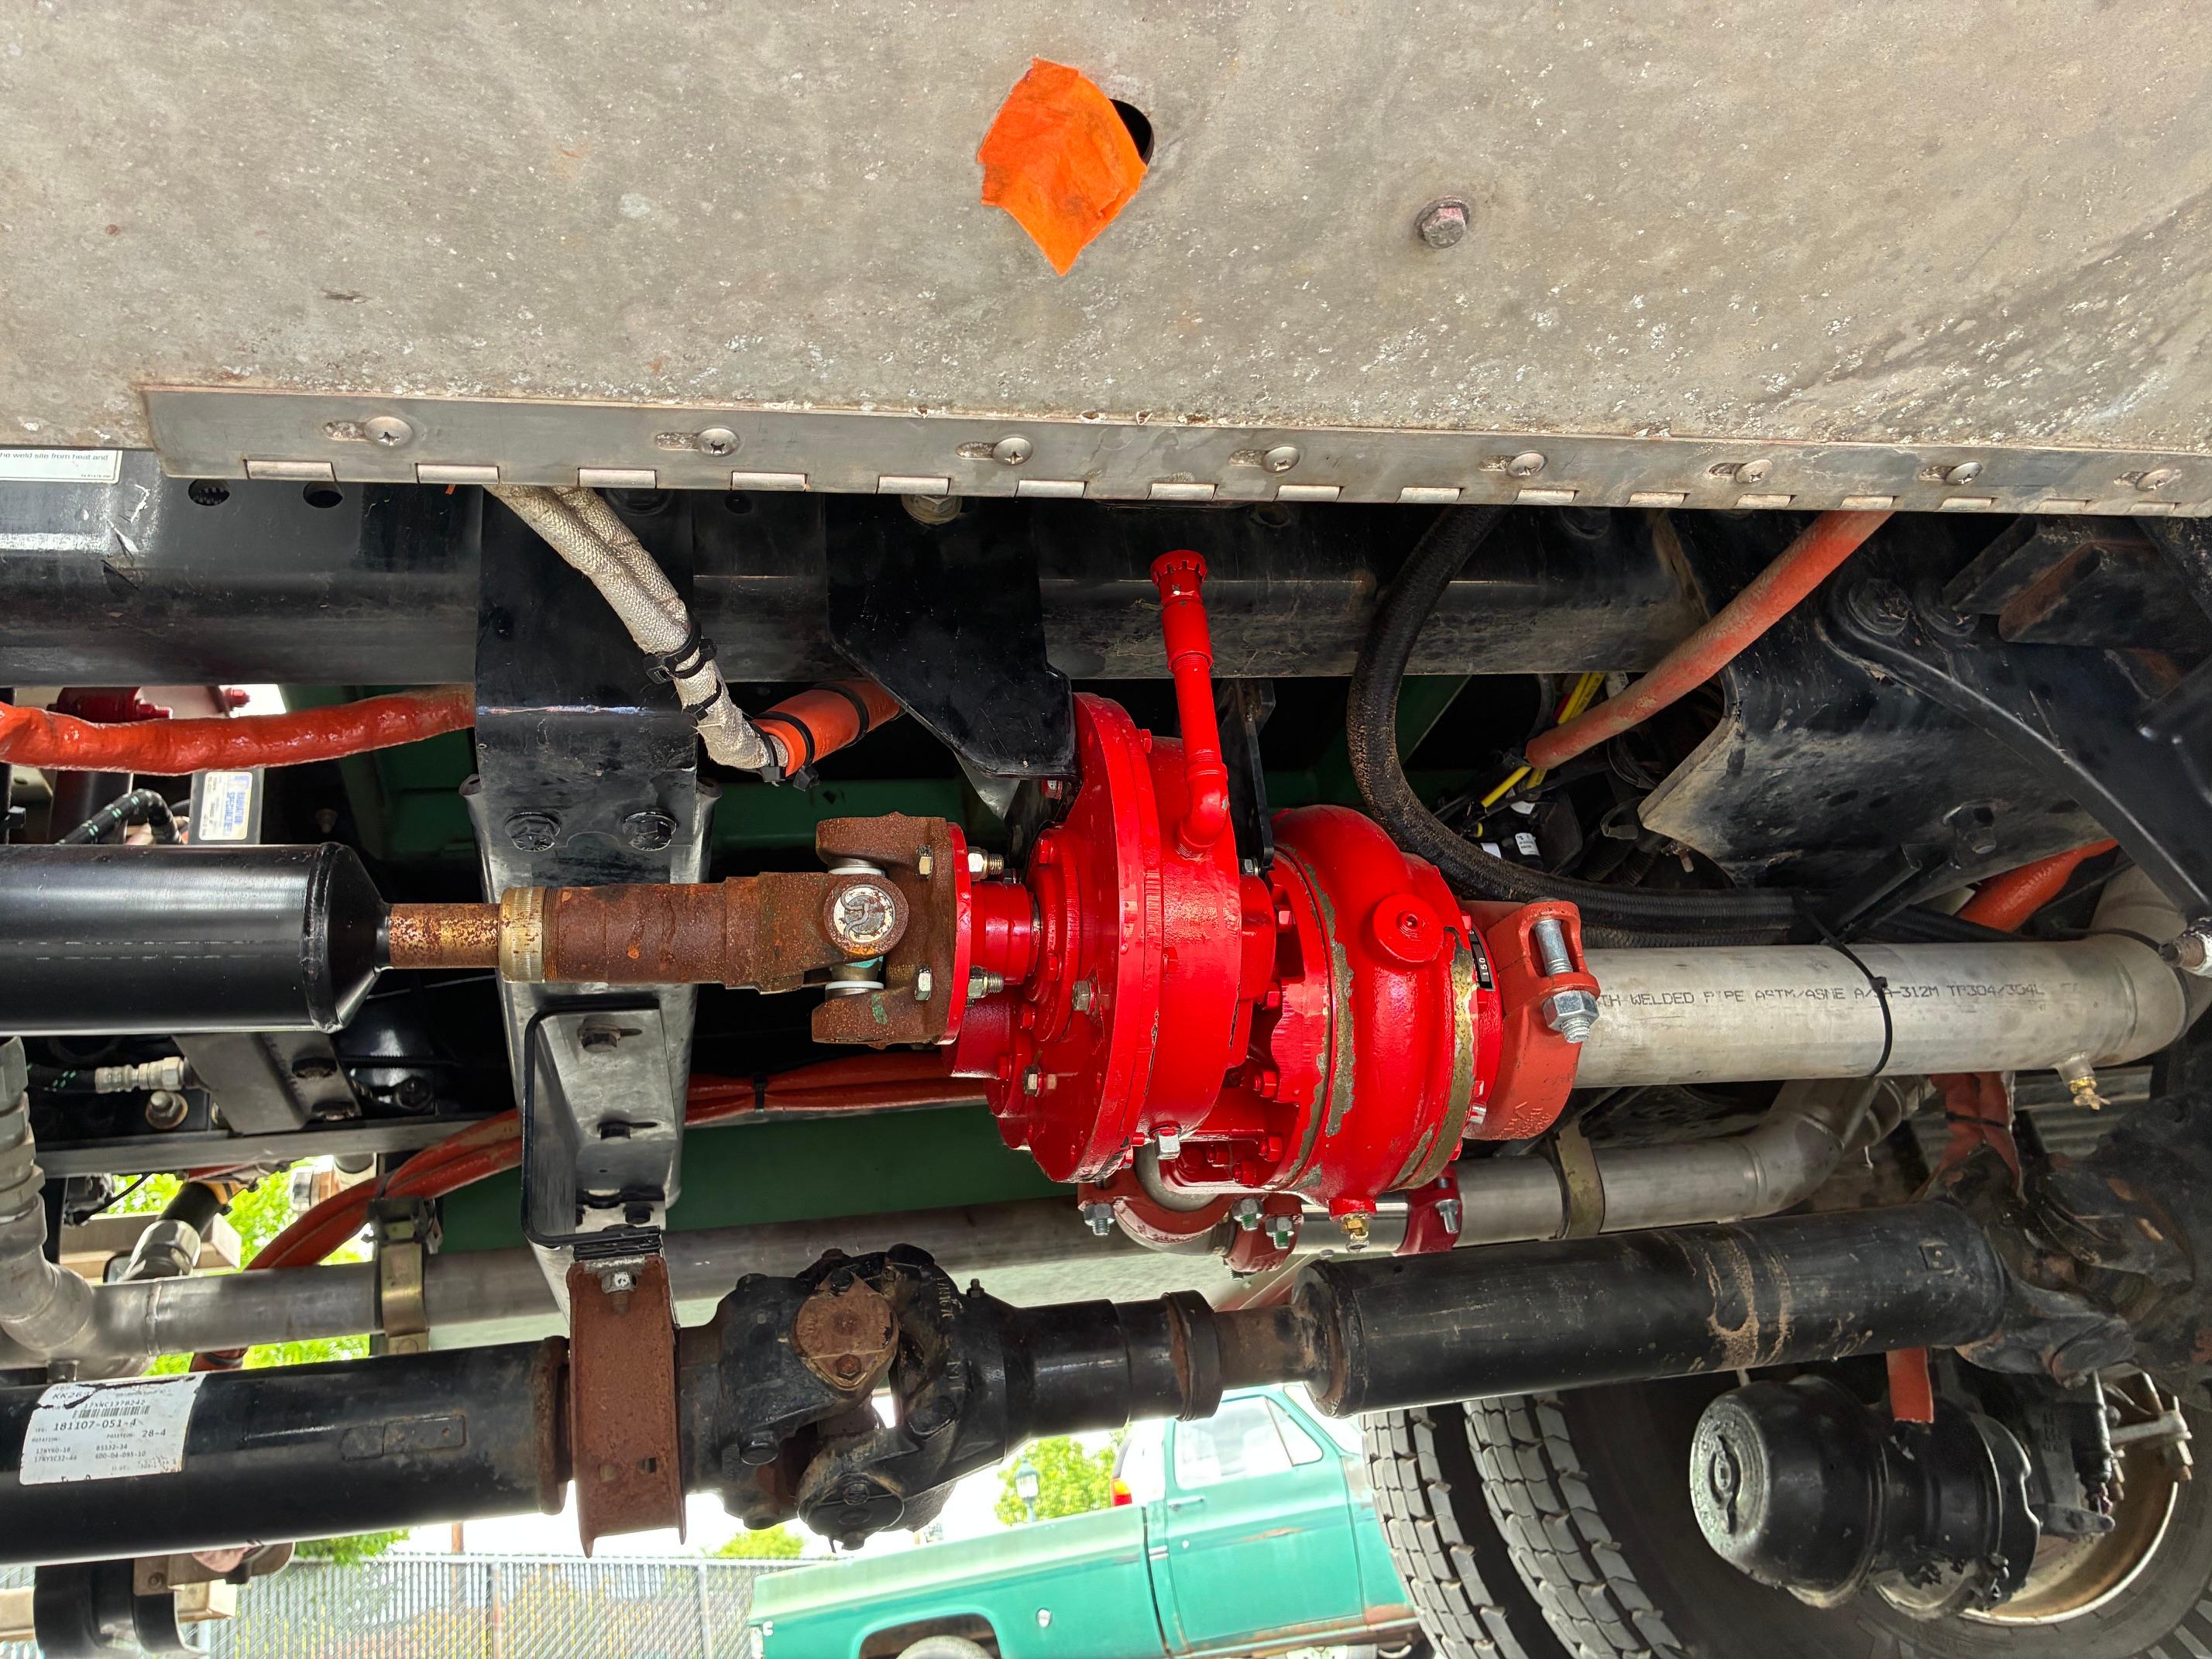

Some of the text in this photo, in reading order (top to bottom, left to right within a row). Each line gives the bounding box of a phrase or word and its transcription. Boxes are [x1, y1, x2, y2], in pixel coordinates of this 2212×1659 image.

[1630, 991, 1695, 1005] WELDED
[1854, 986, 1939, 999] A/A-312M
[53, 1418, 136, 1431] 181107-051-4
[142, 1428, 167, 1438] 28-4
